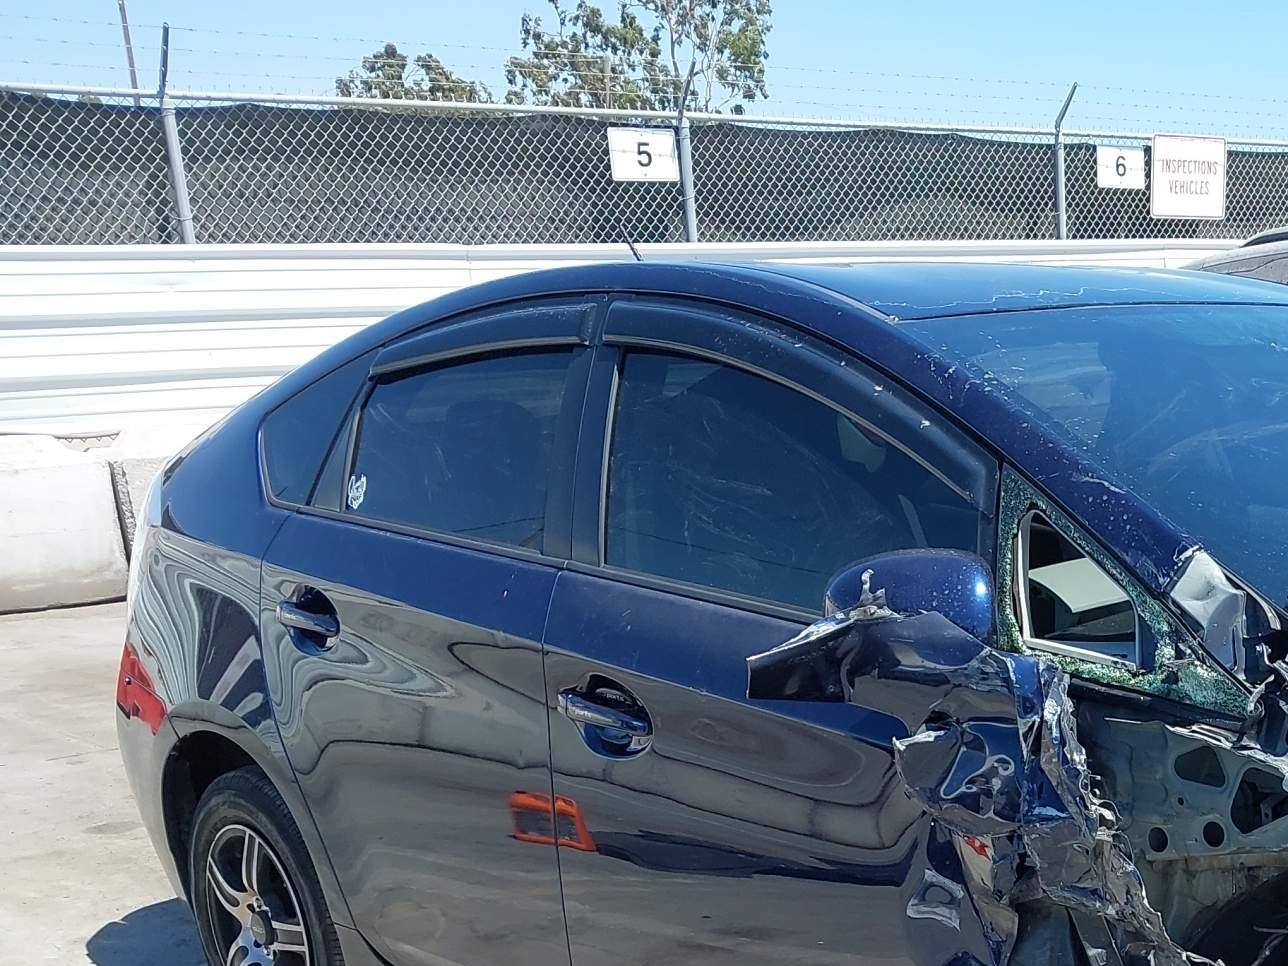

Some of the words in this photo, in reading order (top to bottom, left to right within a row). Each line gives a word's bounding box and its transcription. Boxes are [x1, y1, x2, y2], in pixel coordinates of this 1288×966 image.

[636, 142, 652, 167] 5
[1115, 156, 1127, 177] 6
[1161, 158, 1217, 176] INSPECTIONS
[1168, 179, 1210, 195] VEHICLES
